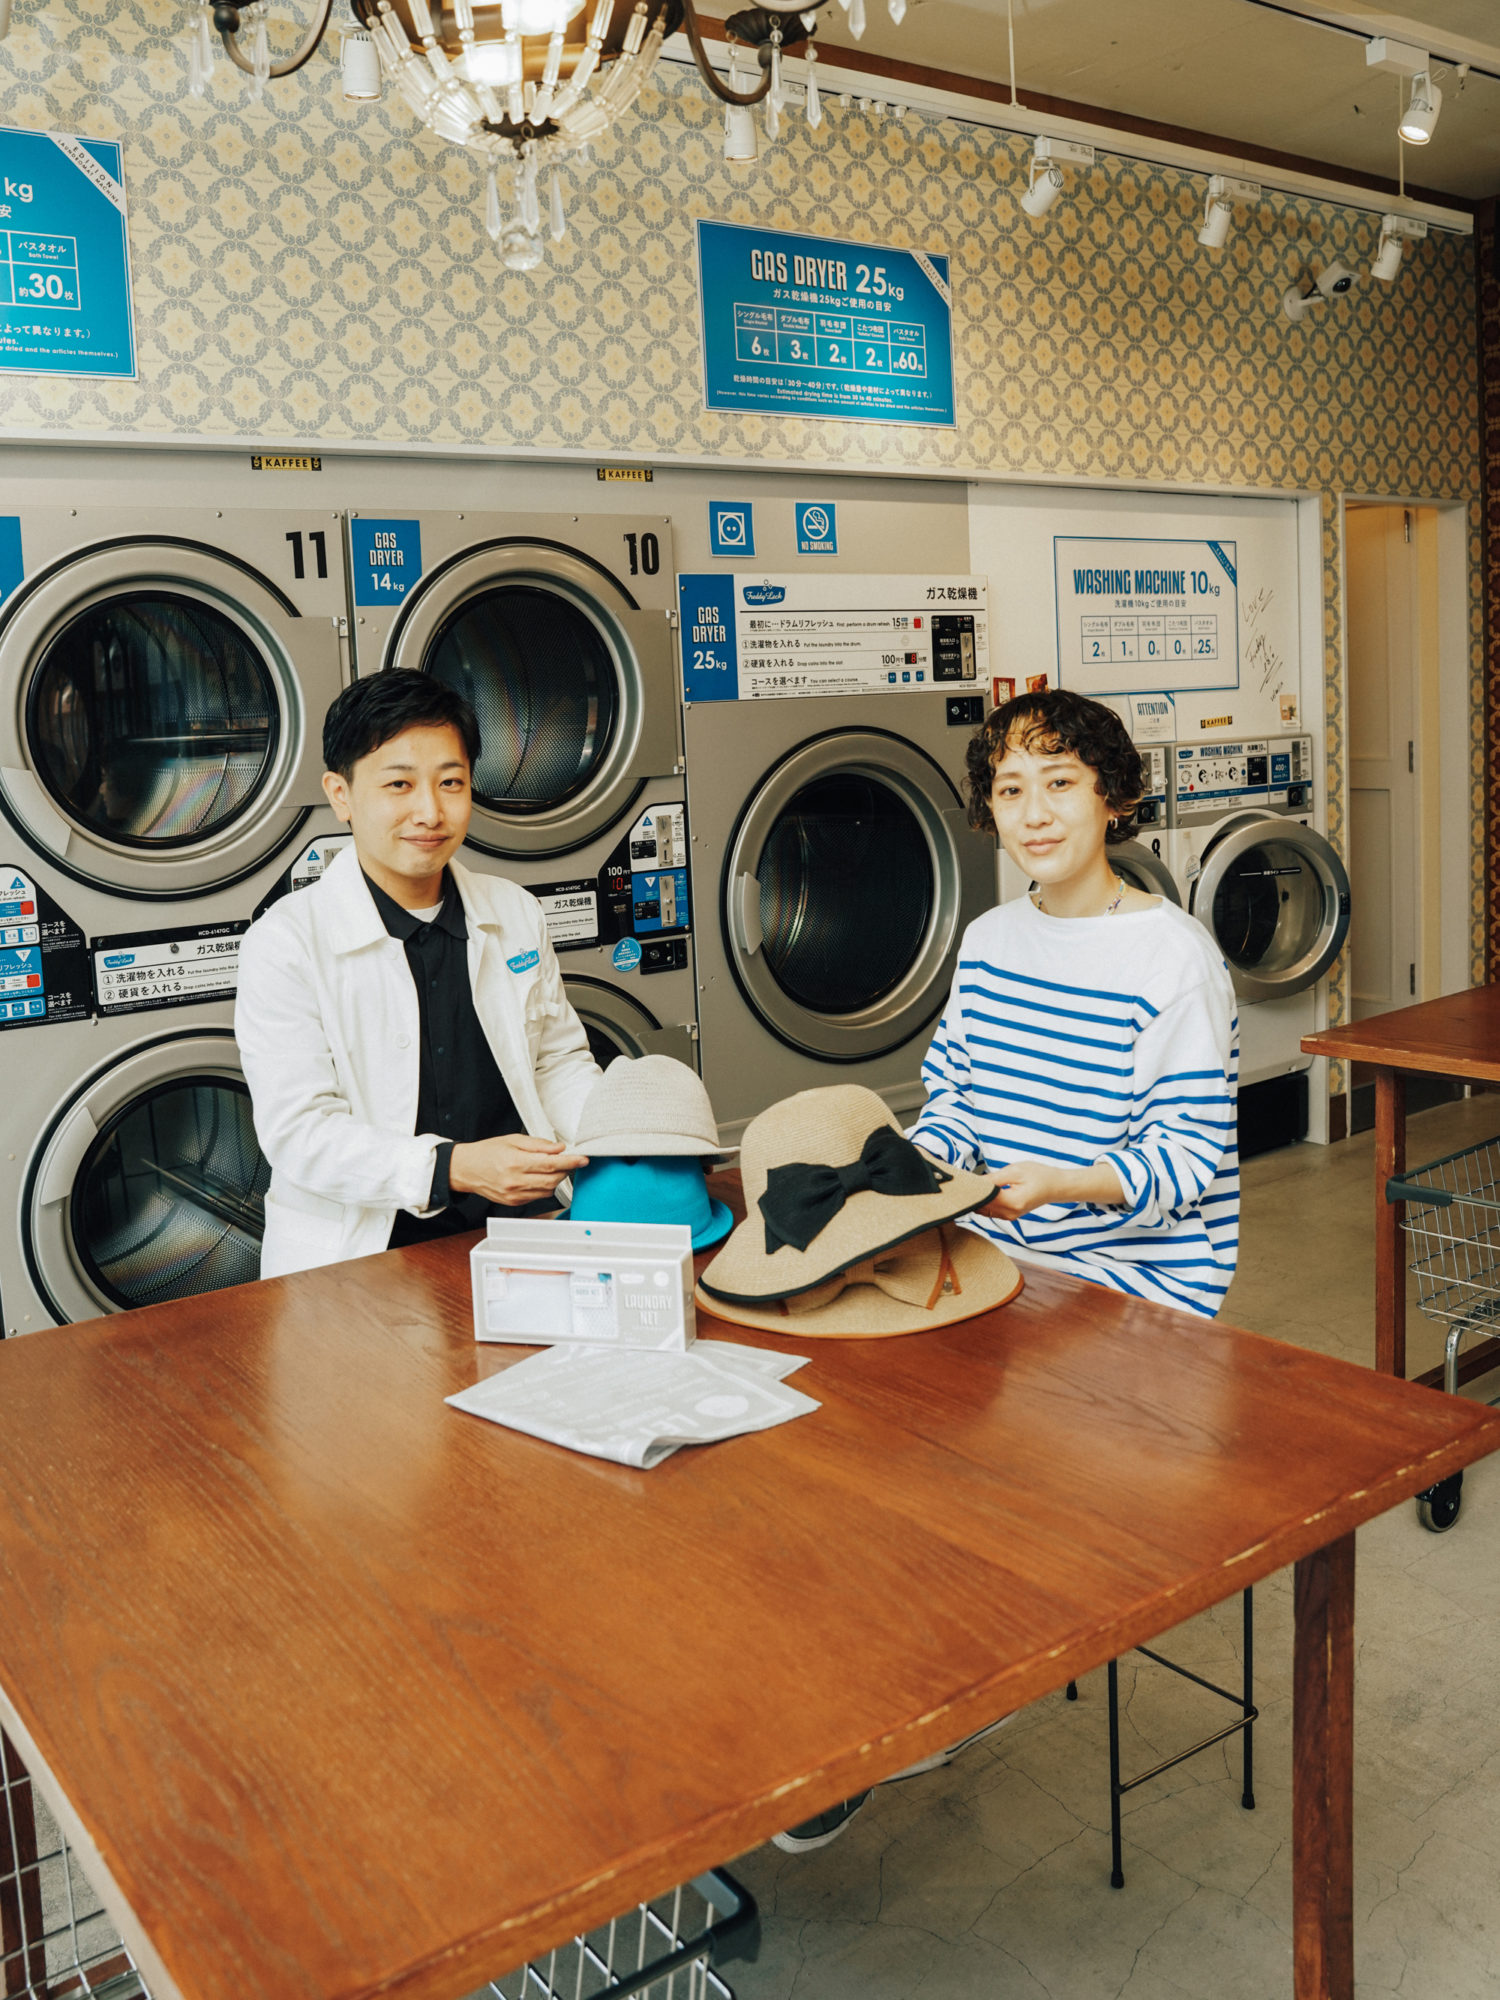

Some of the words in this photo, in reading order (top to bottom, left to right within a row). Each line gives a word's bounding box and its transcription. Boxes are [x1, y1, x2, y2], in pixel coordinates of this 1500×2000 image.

[73, 146, 113, 189] EDITION
[4, 177, 34, 203] kg
[95, 178, 119, 203] MACHINE
[18, 241, 67, 253] バスタオル
[751, 249, 788, 282] GAS
[793, 255, 848, 291] DRYER
[0, 324, 90, 339] よって異なります。)
[265, 458, 309, 468] KAFFEE
[608, 469, 643, 480] KAFFEE
[374, 532, 397, 549] GAS
[801, 541, 809, 551] NO
[810, 541, 834, 551] SMOKING
[285, 531, 328, 579] 11
[369, 548, 405, 567] DRYER
[623, 532, 660, 576] 10
[1073, 569, 1132, 595] WASHING
[1134, 570, 1186, 594] MACHINE
[926, 587, 978, 600] ガス乾燥機
[697, 606, 720, 624] GAS
[692, 625, 727, 644] DRYER
[751, 676, 808, 686] コースを選べます
[1137, 702, 1169, 716] ATTENTION
[1200, 746, 1222, 757] WASHING
[612, 877, 624, 891] 10
[554, 896, 592, 909] ガス乾燥機
[41, 920, 67, 929] コースを
[41, 928, 67, 936] 選べます
[116, 965, 185, 985] 洗濯物を入れる
[47, 991, 73, 1001] コースを
[118, 982, 182, 999] 硬貨を入れる
[47, 999, 73, 1008] 選べます
[624, 1294, 672, 1310] LAUNDRY
[640, 1311, 658, 1326] NET
